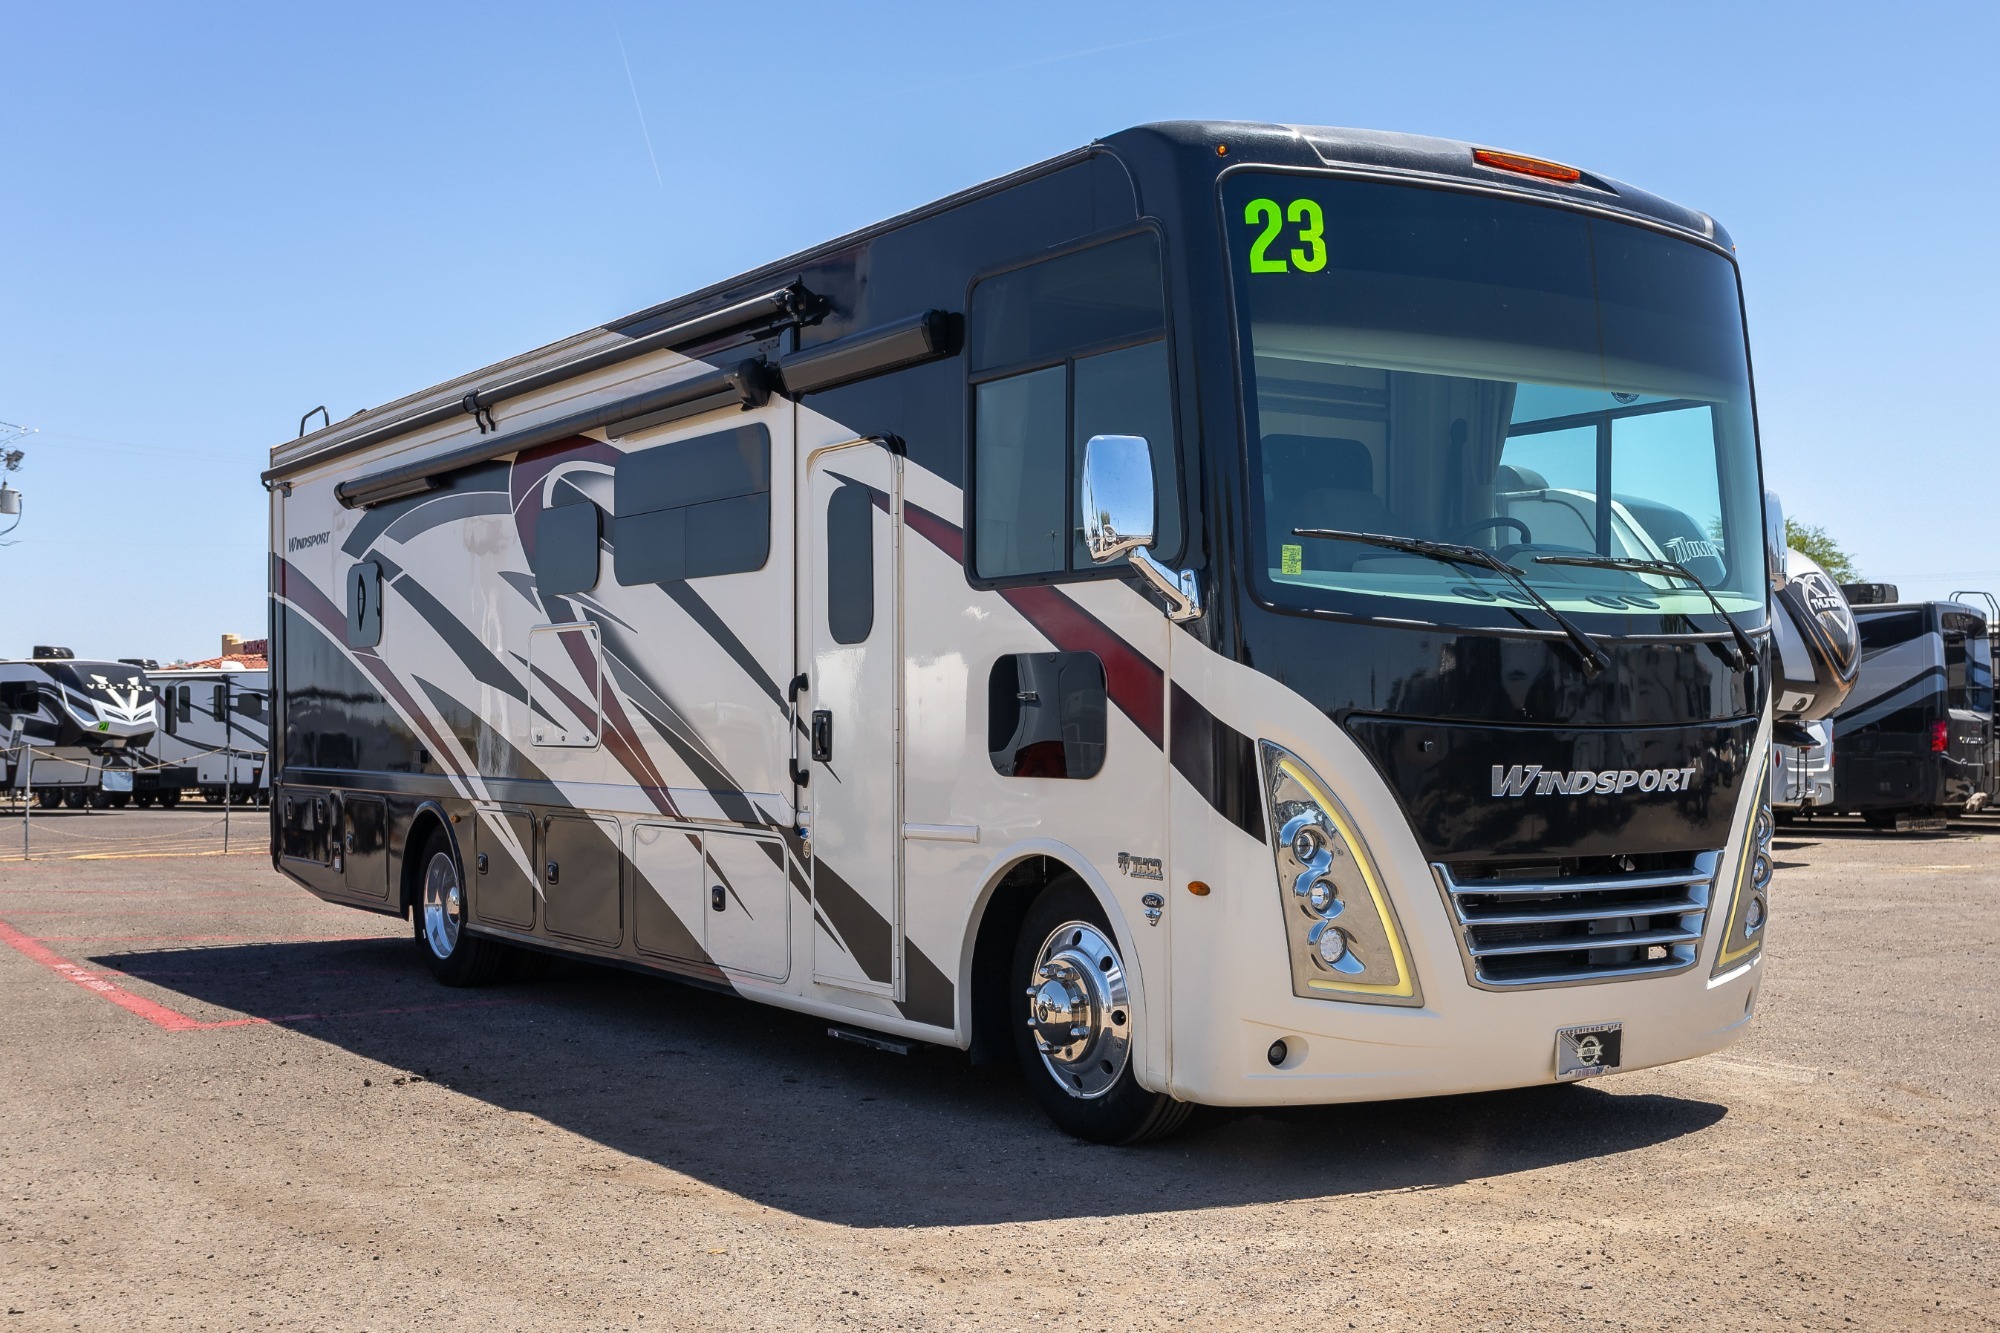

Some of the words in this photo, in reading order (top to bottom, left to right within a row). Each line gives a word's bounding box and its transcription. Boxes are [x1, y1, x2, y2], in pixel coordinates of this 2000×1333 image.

[1245, 199, 1327, 273] 23
[289, 531, 330, 552] WINDSPORT
[87, 684, 152, 692] VOLTAGE
[1492, 765, 1696, 796] WINDSPORT
[1130, 856, 1163, 875] THOR
